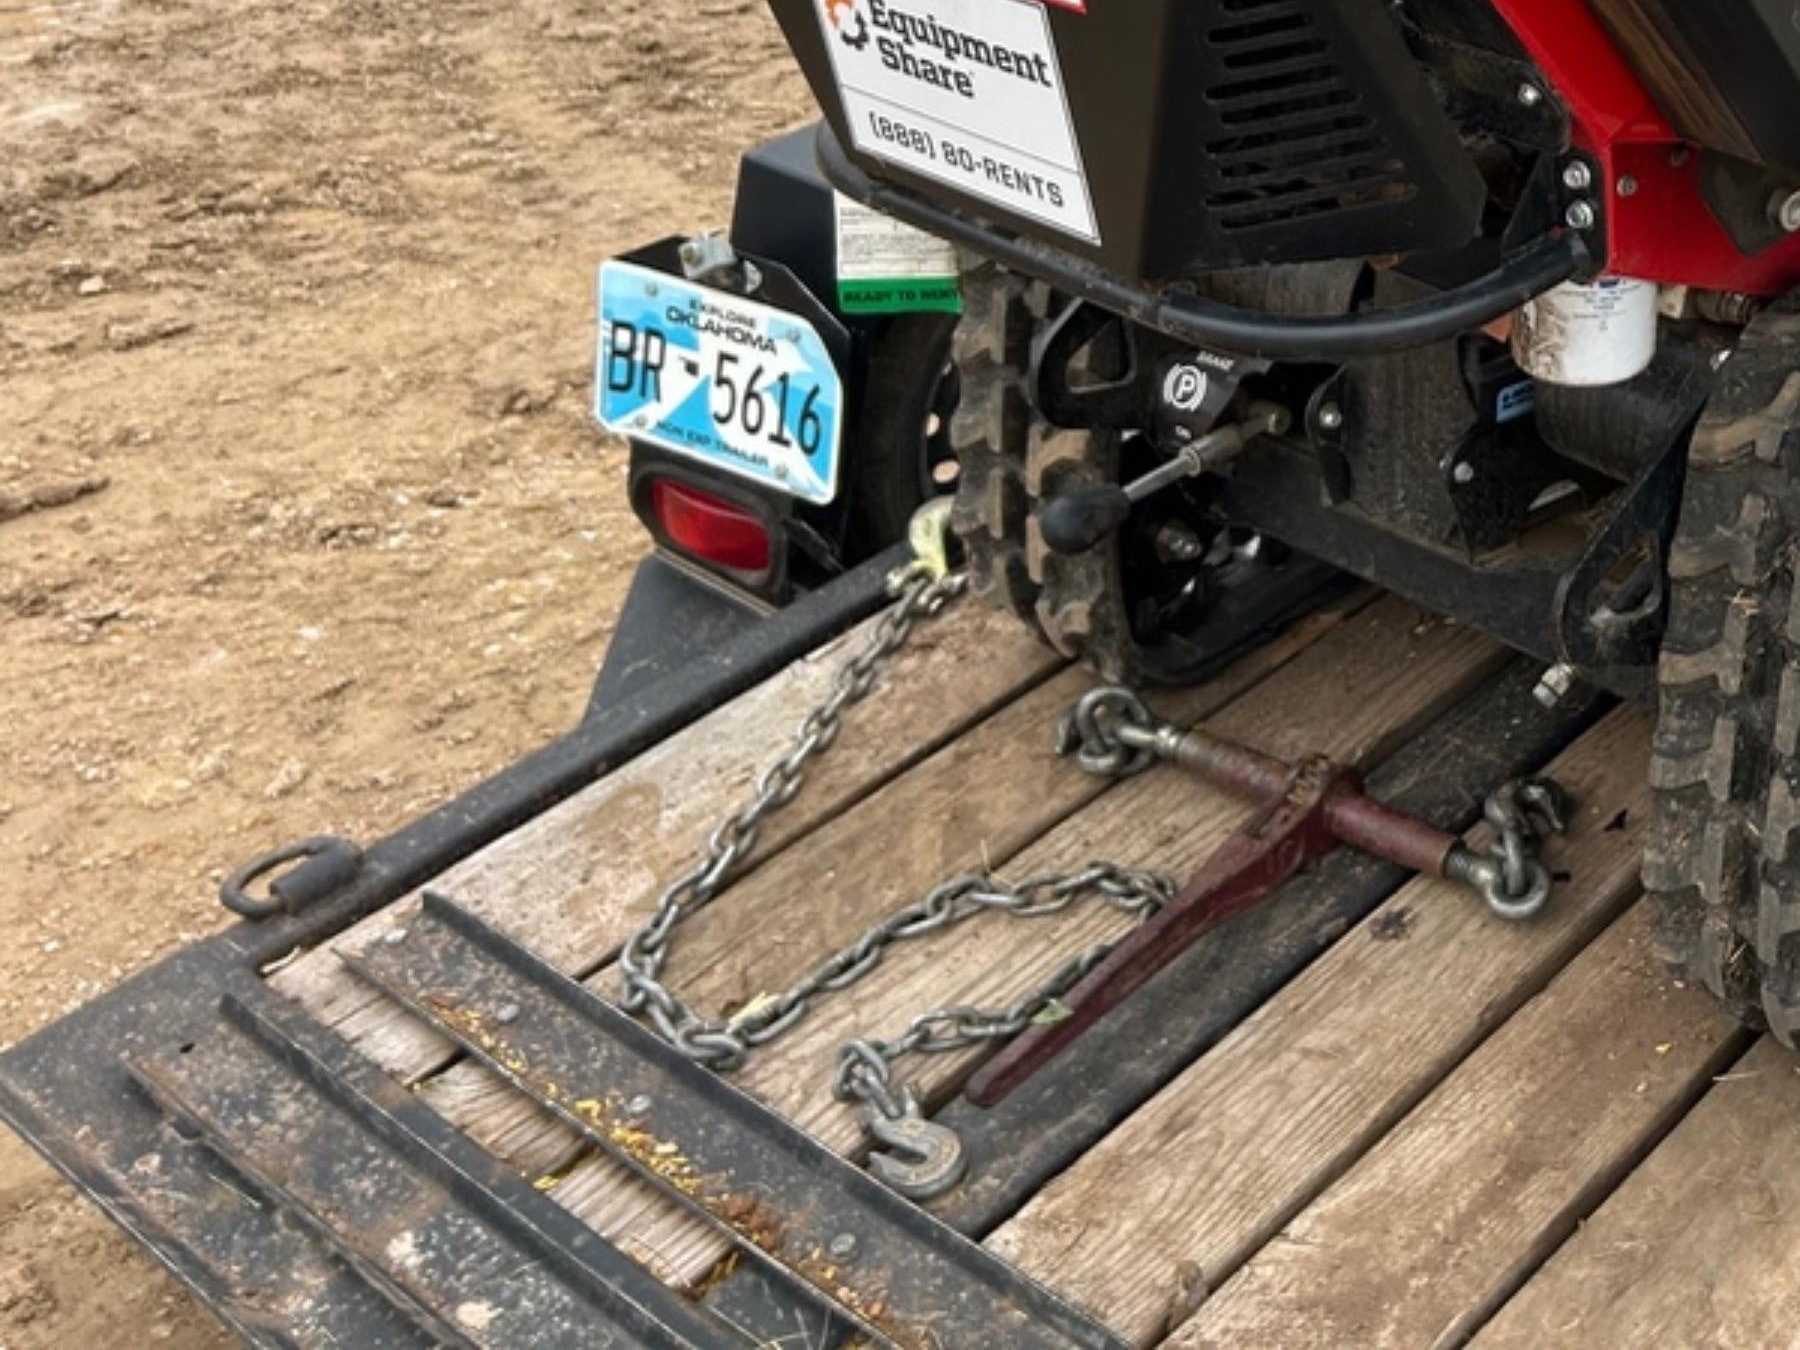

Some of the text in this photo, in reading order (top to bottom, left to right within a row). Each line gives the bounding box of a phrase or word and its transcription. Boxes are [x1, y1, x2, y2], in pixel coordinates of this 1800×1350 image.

[876, 36, 975, 99] Share
[868, 111, 1064, 207] (888) 80-RENTS
[665, 305, 778, 355] OKLAHOMA
[688, 298, 757, 329] EXPLORE
[608, 320, 822, 456] BR 5616
